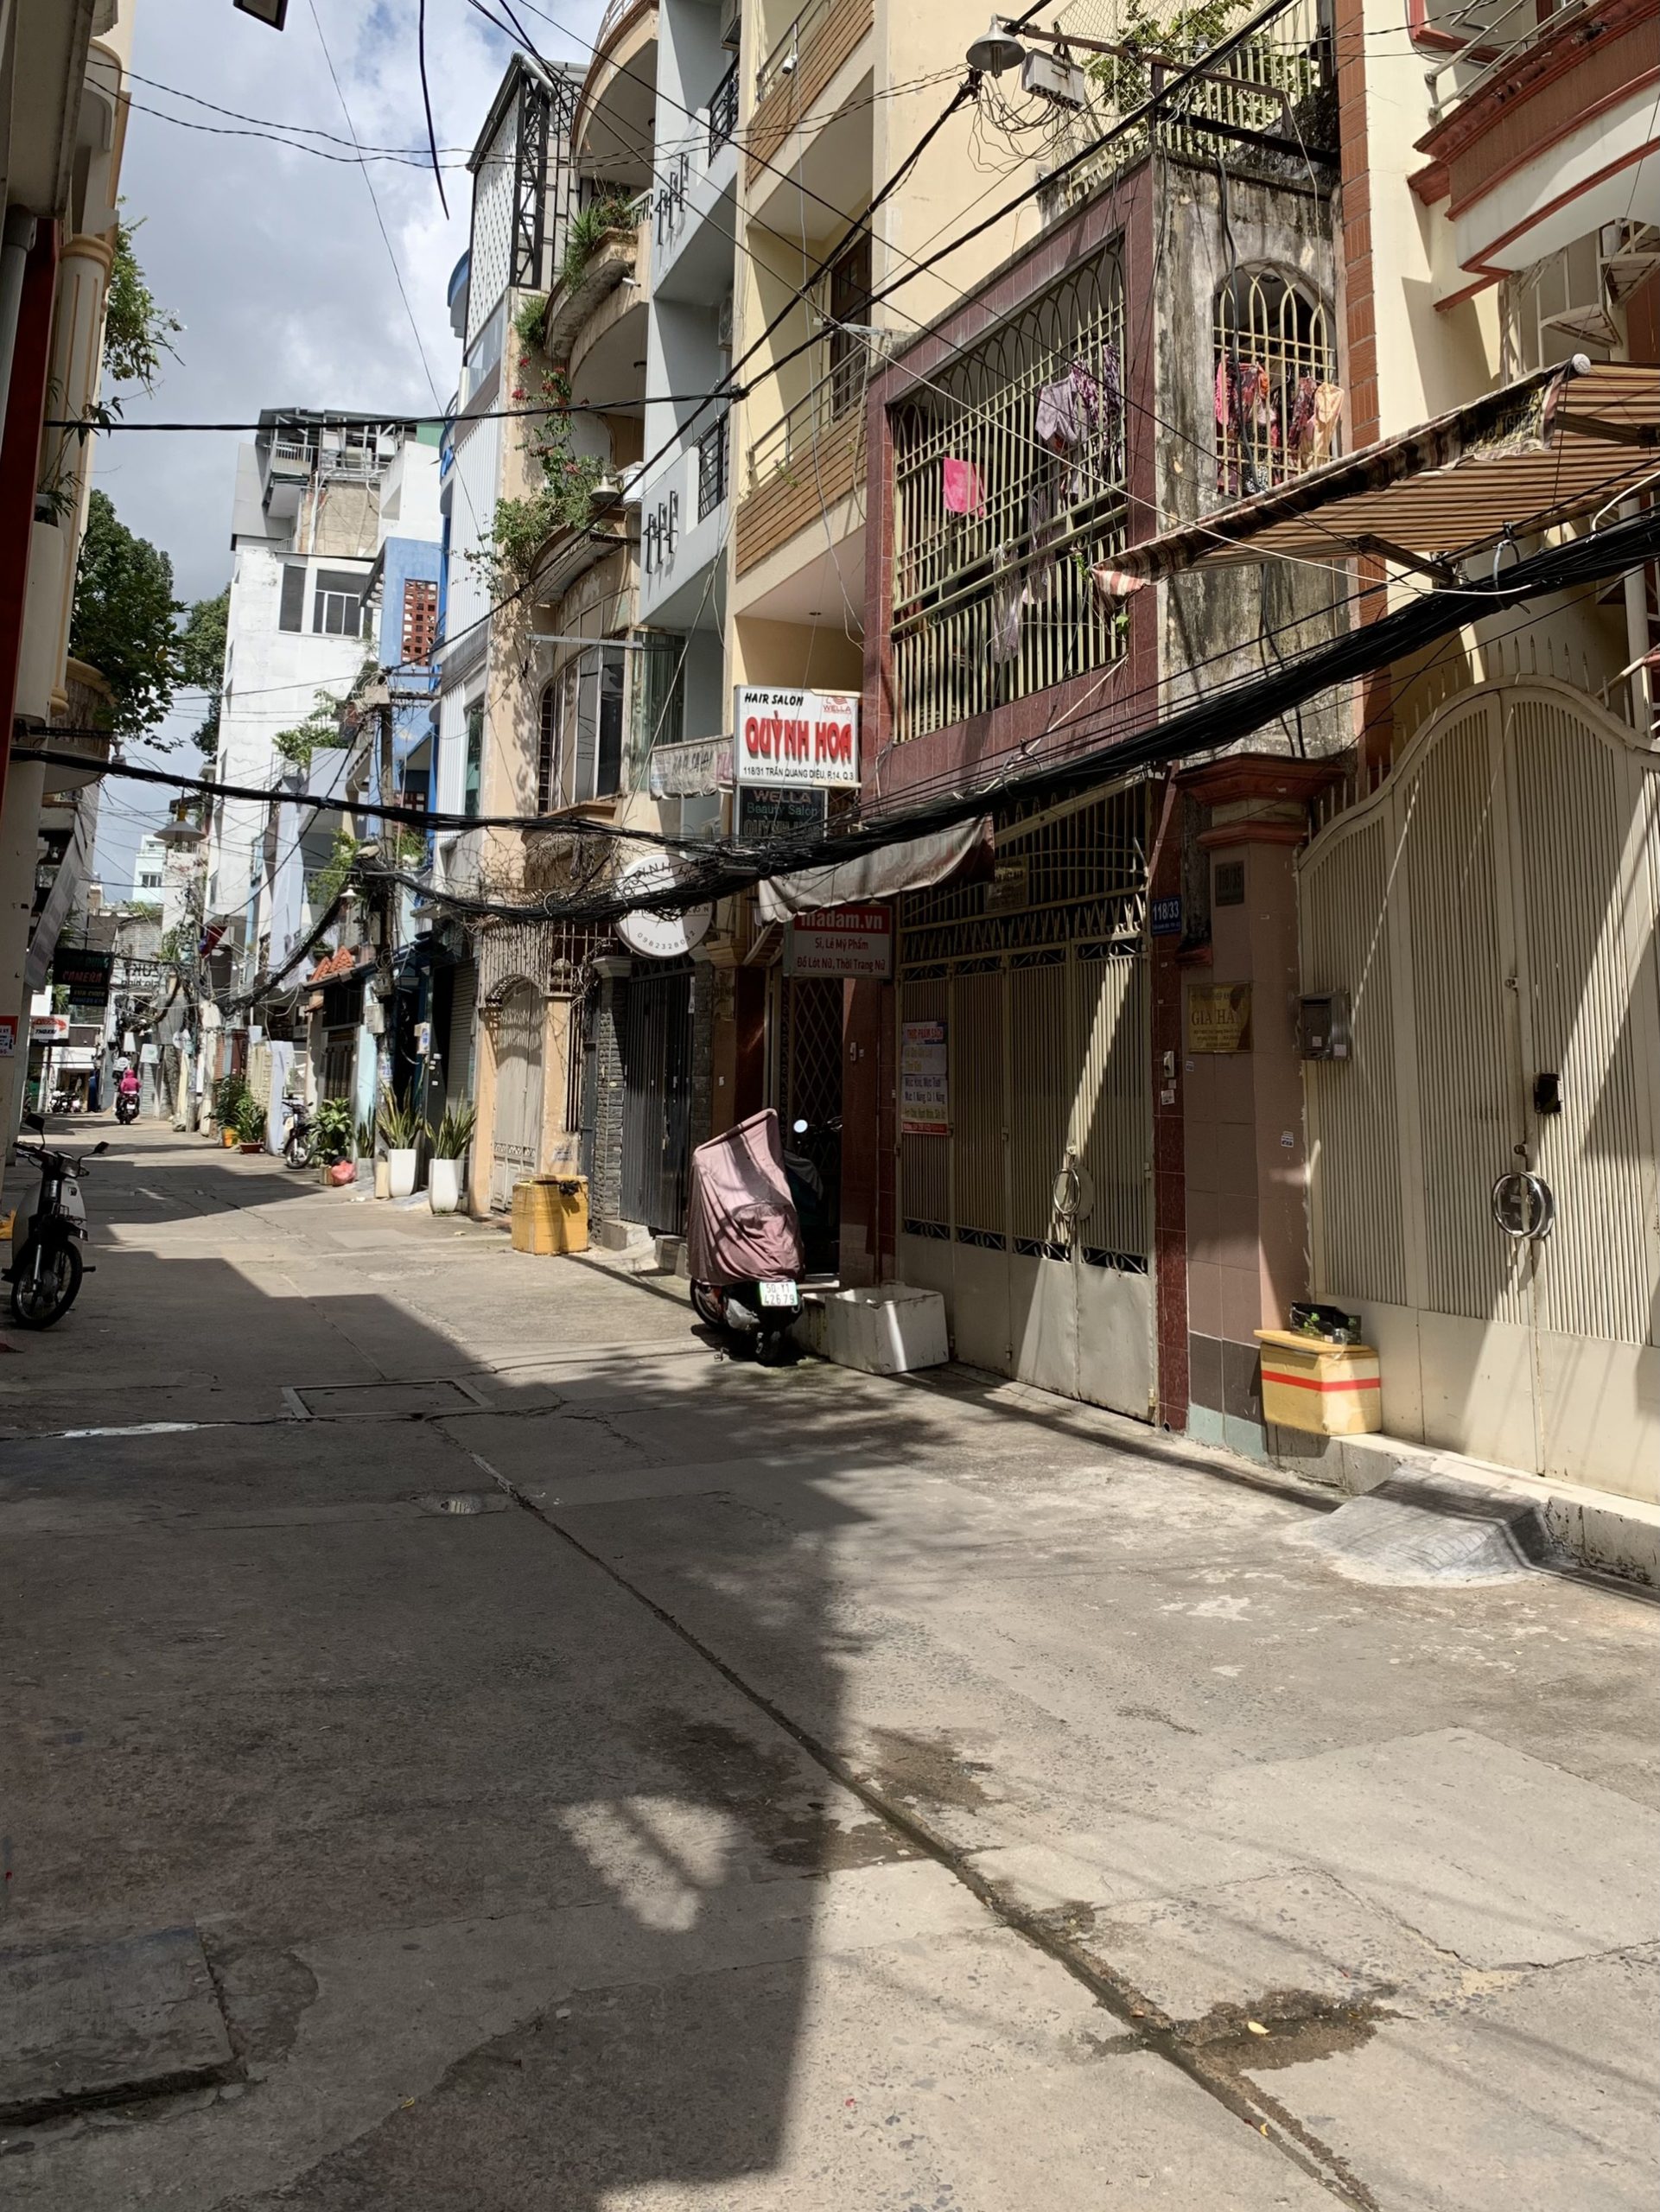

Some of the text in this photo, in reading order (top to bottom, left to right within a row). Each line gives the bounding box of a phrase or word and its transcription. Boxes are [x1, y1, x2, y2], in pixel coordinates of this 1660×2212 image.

[745, 693, 805, 706] HAIR SALON
[823, 704, 852, 714] WELLA
[745, 709, 852, 766] QUỲNH HOA
[743, 766, 765, 776] 118/31
[784, 768, 809, 779] QUANG
[753, 790, 812, 804] WELLA
[787, 804, 817, 816] Salon
[1153, 900, 1180, 921] 118/33
[800, 910, 882, 931] madam.vn
[854, 958, 874, 972] Trang
[1192, 1008, 1212, 1026] GIA
